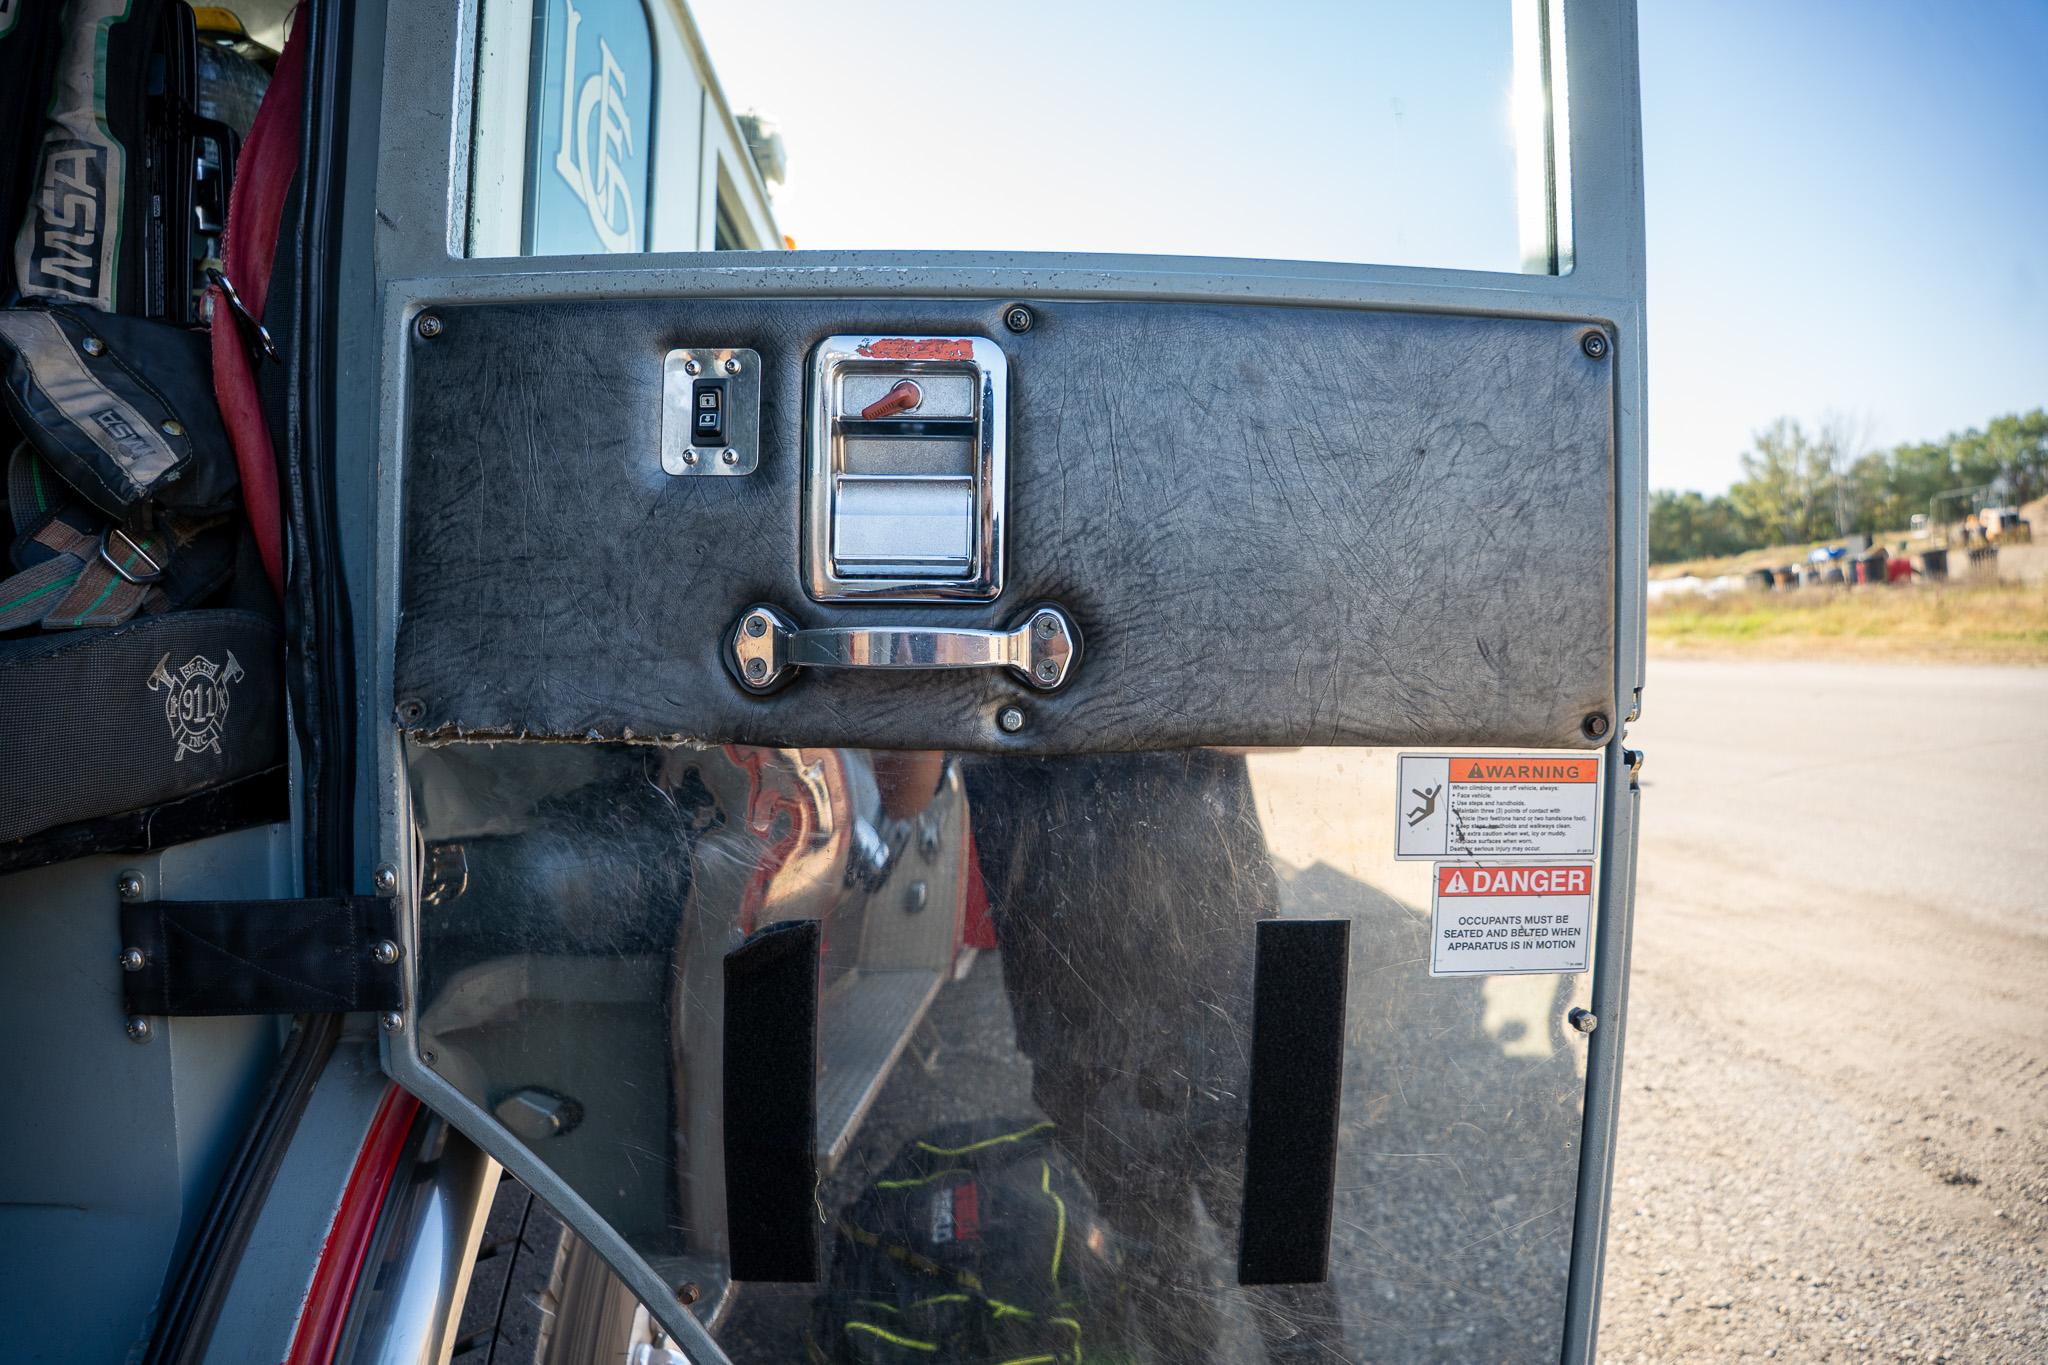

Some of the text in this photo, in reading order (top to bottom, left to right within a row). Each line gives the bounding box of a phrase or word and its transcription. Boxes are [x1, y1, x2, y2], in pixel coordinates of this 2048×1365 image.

[41, 148, 98, 289] MSA
[95, 410, 156, 459] MSA
[184, 660, 216, 677] SEATS
[182, 684, 216, 723] 911
[188, 733, 208, 748] INC
[1486, 765, 1580, 779] WARNING
[1473, 870, 1585, 893] DANGER
[1458, 914, 1569, 926] OCCUPANTS MUST BE
[1443, 927, 1581, 939] SEATED AND BELTED WHEN
[1447, 940, 1576, 951] APPARATUS IS IN MOTION
